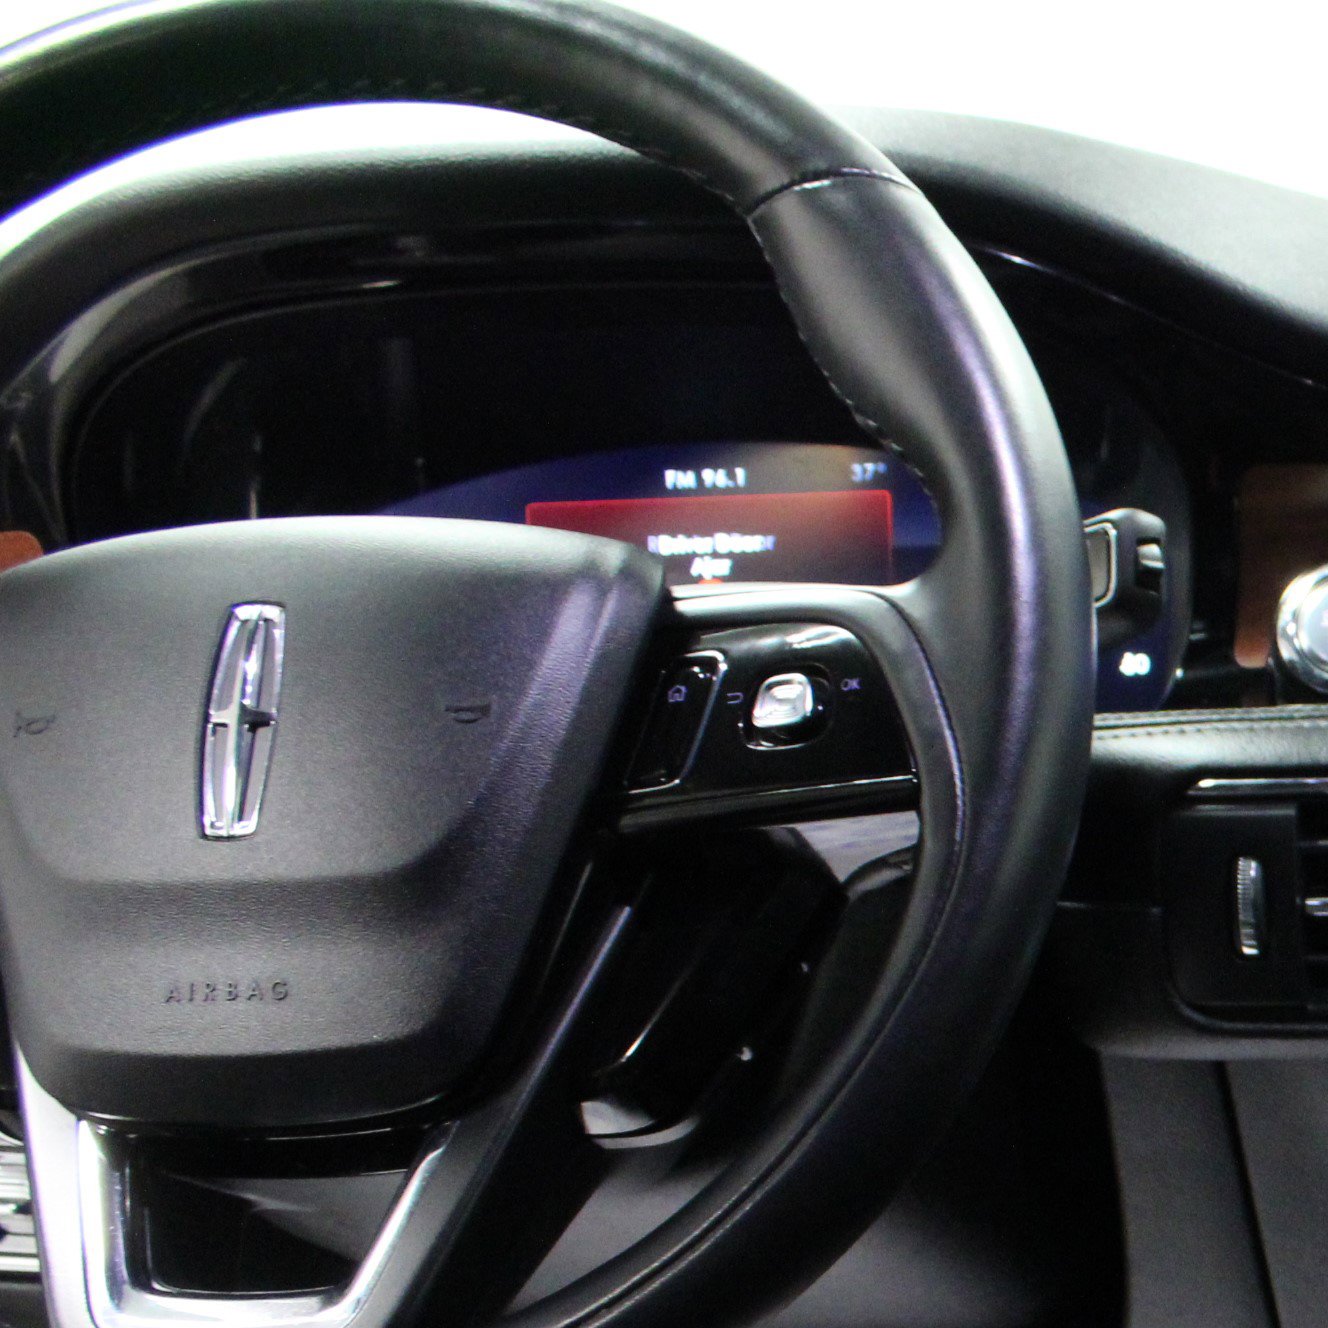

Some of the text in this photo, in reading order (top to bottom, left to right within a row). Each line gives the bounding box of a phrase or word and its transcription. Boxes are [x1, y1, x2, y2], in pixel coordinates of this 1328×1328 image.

[664, 467, 747, 491] FM 96.1
[840, 678, 862, 692] OK
[164, 980, 290, 1004] AIRBAG
